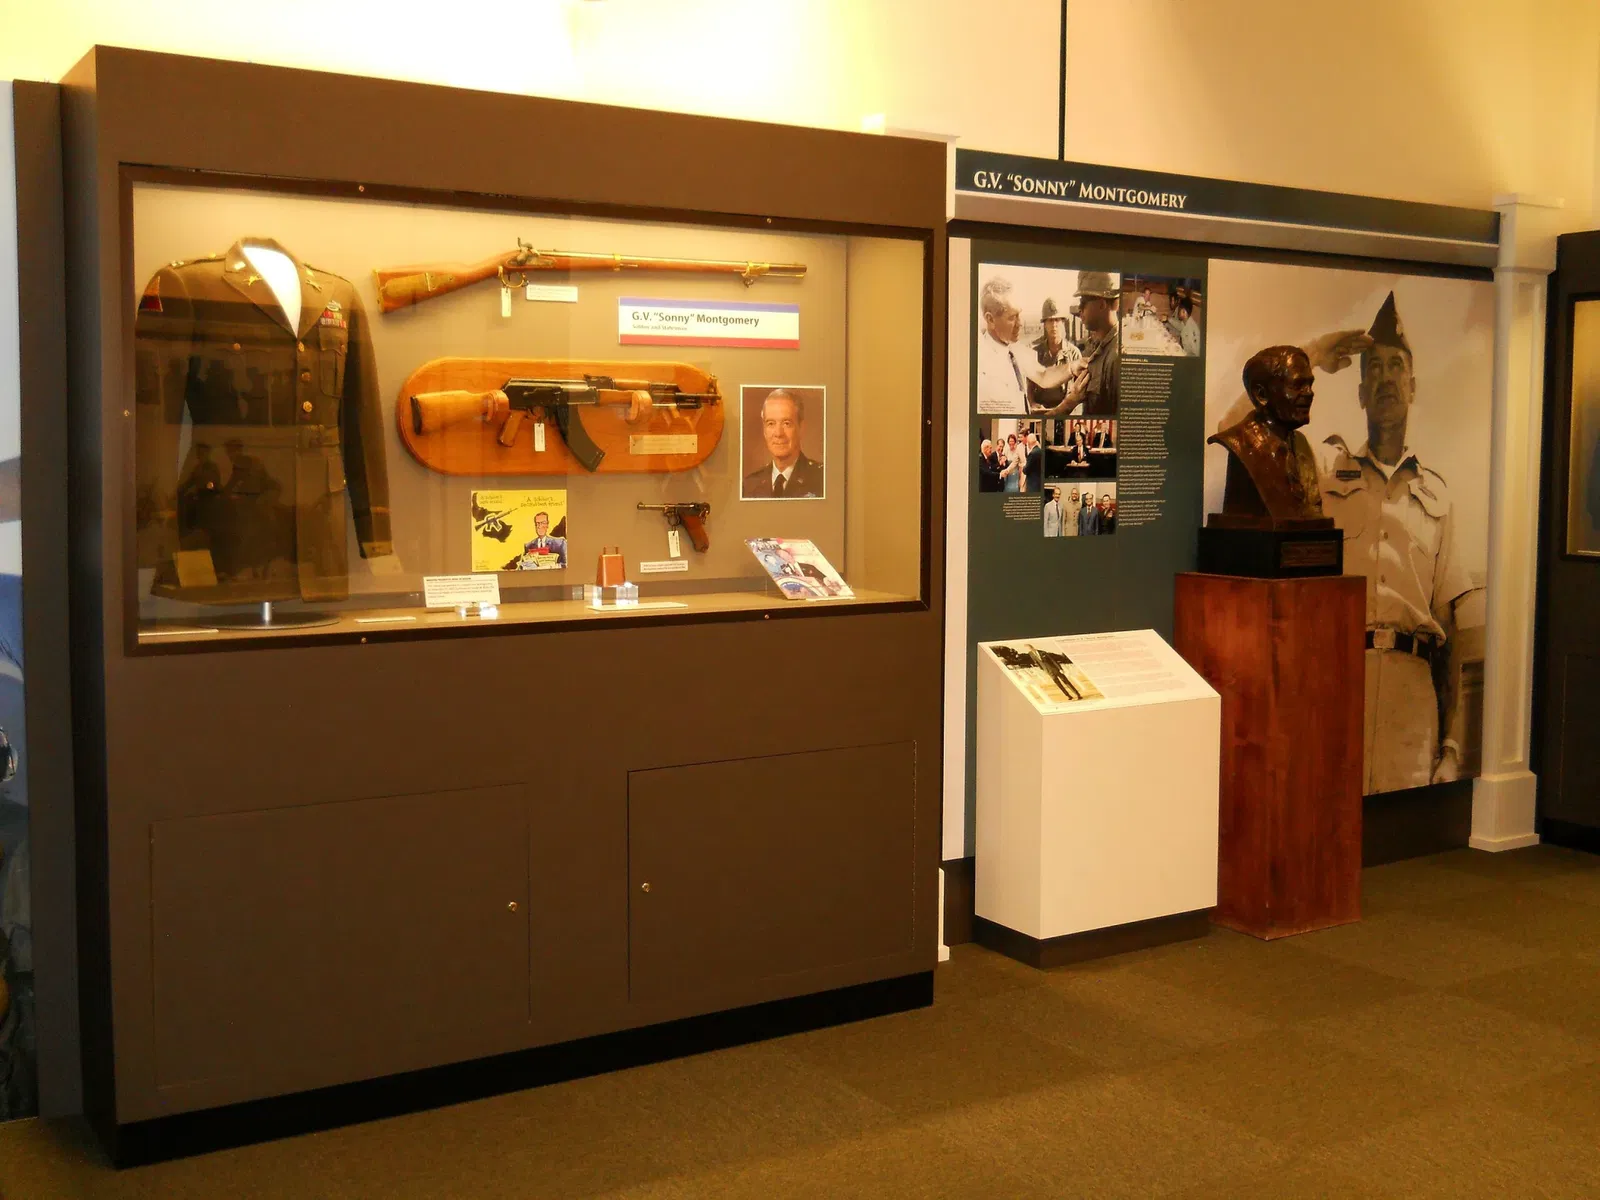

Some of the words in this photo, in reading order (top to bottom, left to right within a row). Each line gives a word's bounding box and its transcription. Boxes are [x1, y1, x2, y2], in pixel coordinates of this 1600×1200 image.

[973, 170, 1003, 190] G.V.
[1079, 182, 1187, 208] MONTGOMERY
[632, 311, 652, 321] G.V.
[697, 314, 759, 326] Montgomery
